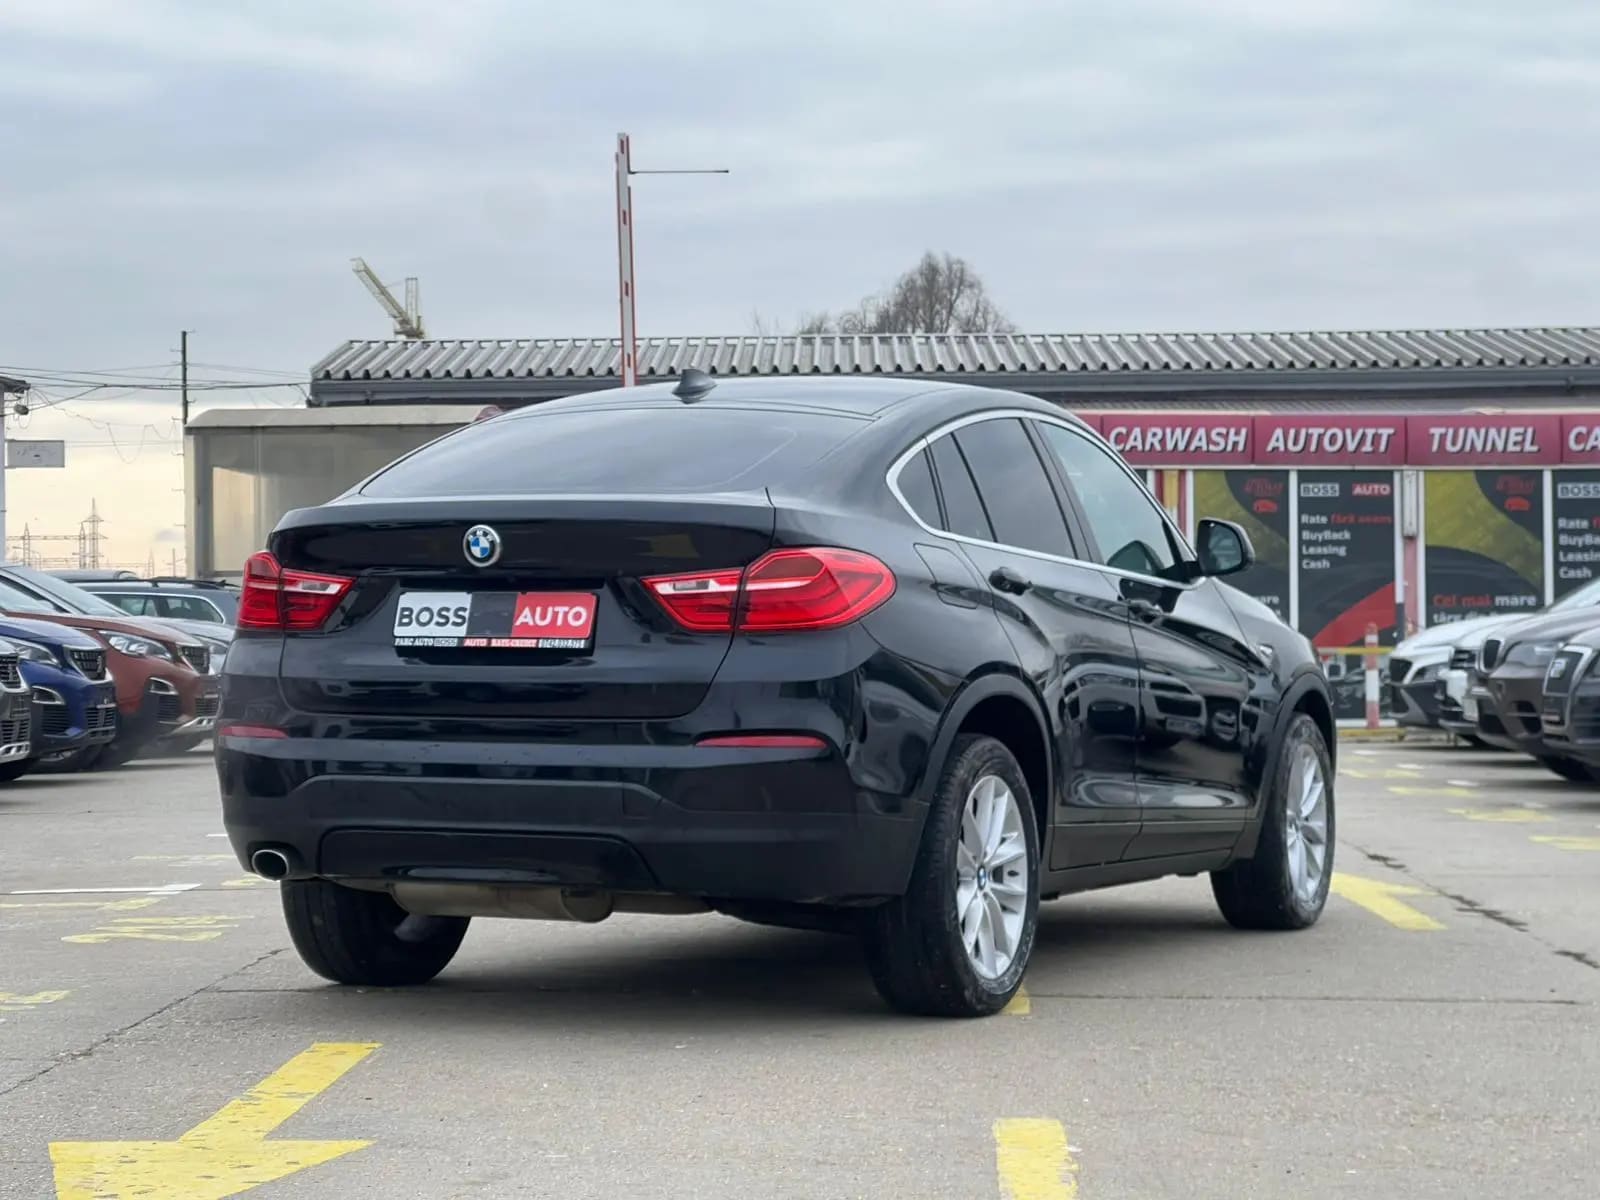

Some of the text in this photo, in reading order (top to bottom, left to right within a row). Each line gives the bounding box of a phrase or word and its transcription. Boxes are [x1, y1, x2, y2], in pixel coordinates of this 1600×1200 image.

[1109, 426, 1248, 453] CARWASH
[1266, 426, 1396, 454] AUTOVIT
[1429, 426, 1541, 453] TUNNEL
[1303, 483, 1391, 496] BOSS AUTO
[1301, 513, 1328, 524] Rate
[1558, 517, 1589, 529] Rate
[1302, 529, 1351, 543] BuyBack
[1302, 544, 1347, 557] Leasing
[1302, 558, 1330, 570] Cash
[1559, 566, 1592, 579] Cash
[1495, 595, 1537, 607] mare
[396, 606, 588, 628] BOSS AUTO
[413, 637, 433, 647] AUTO
